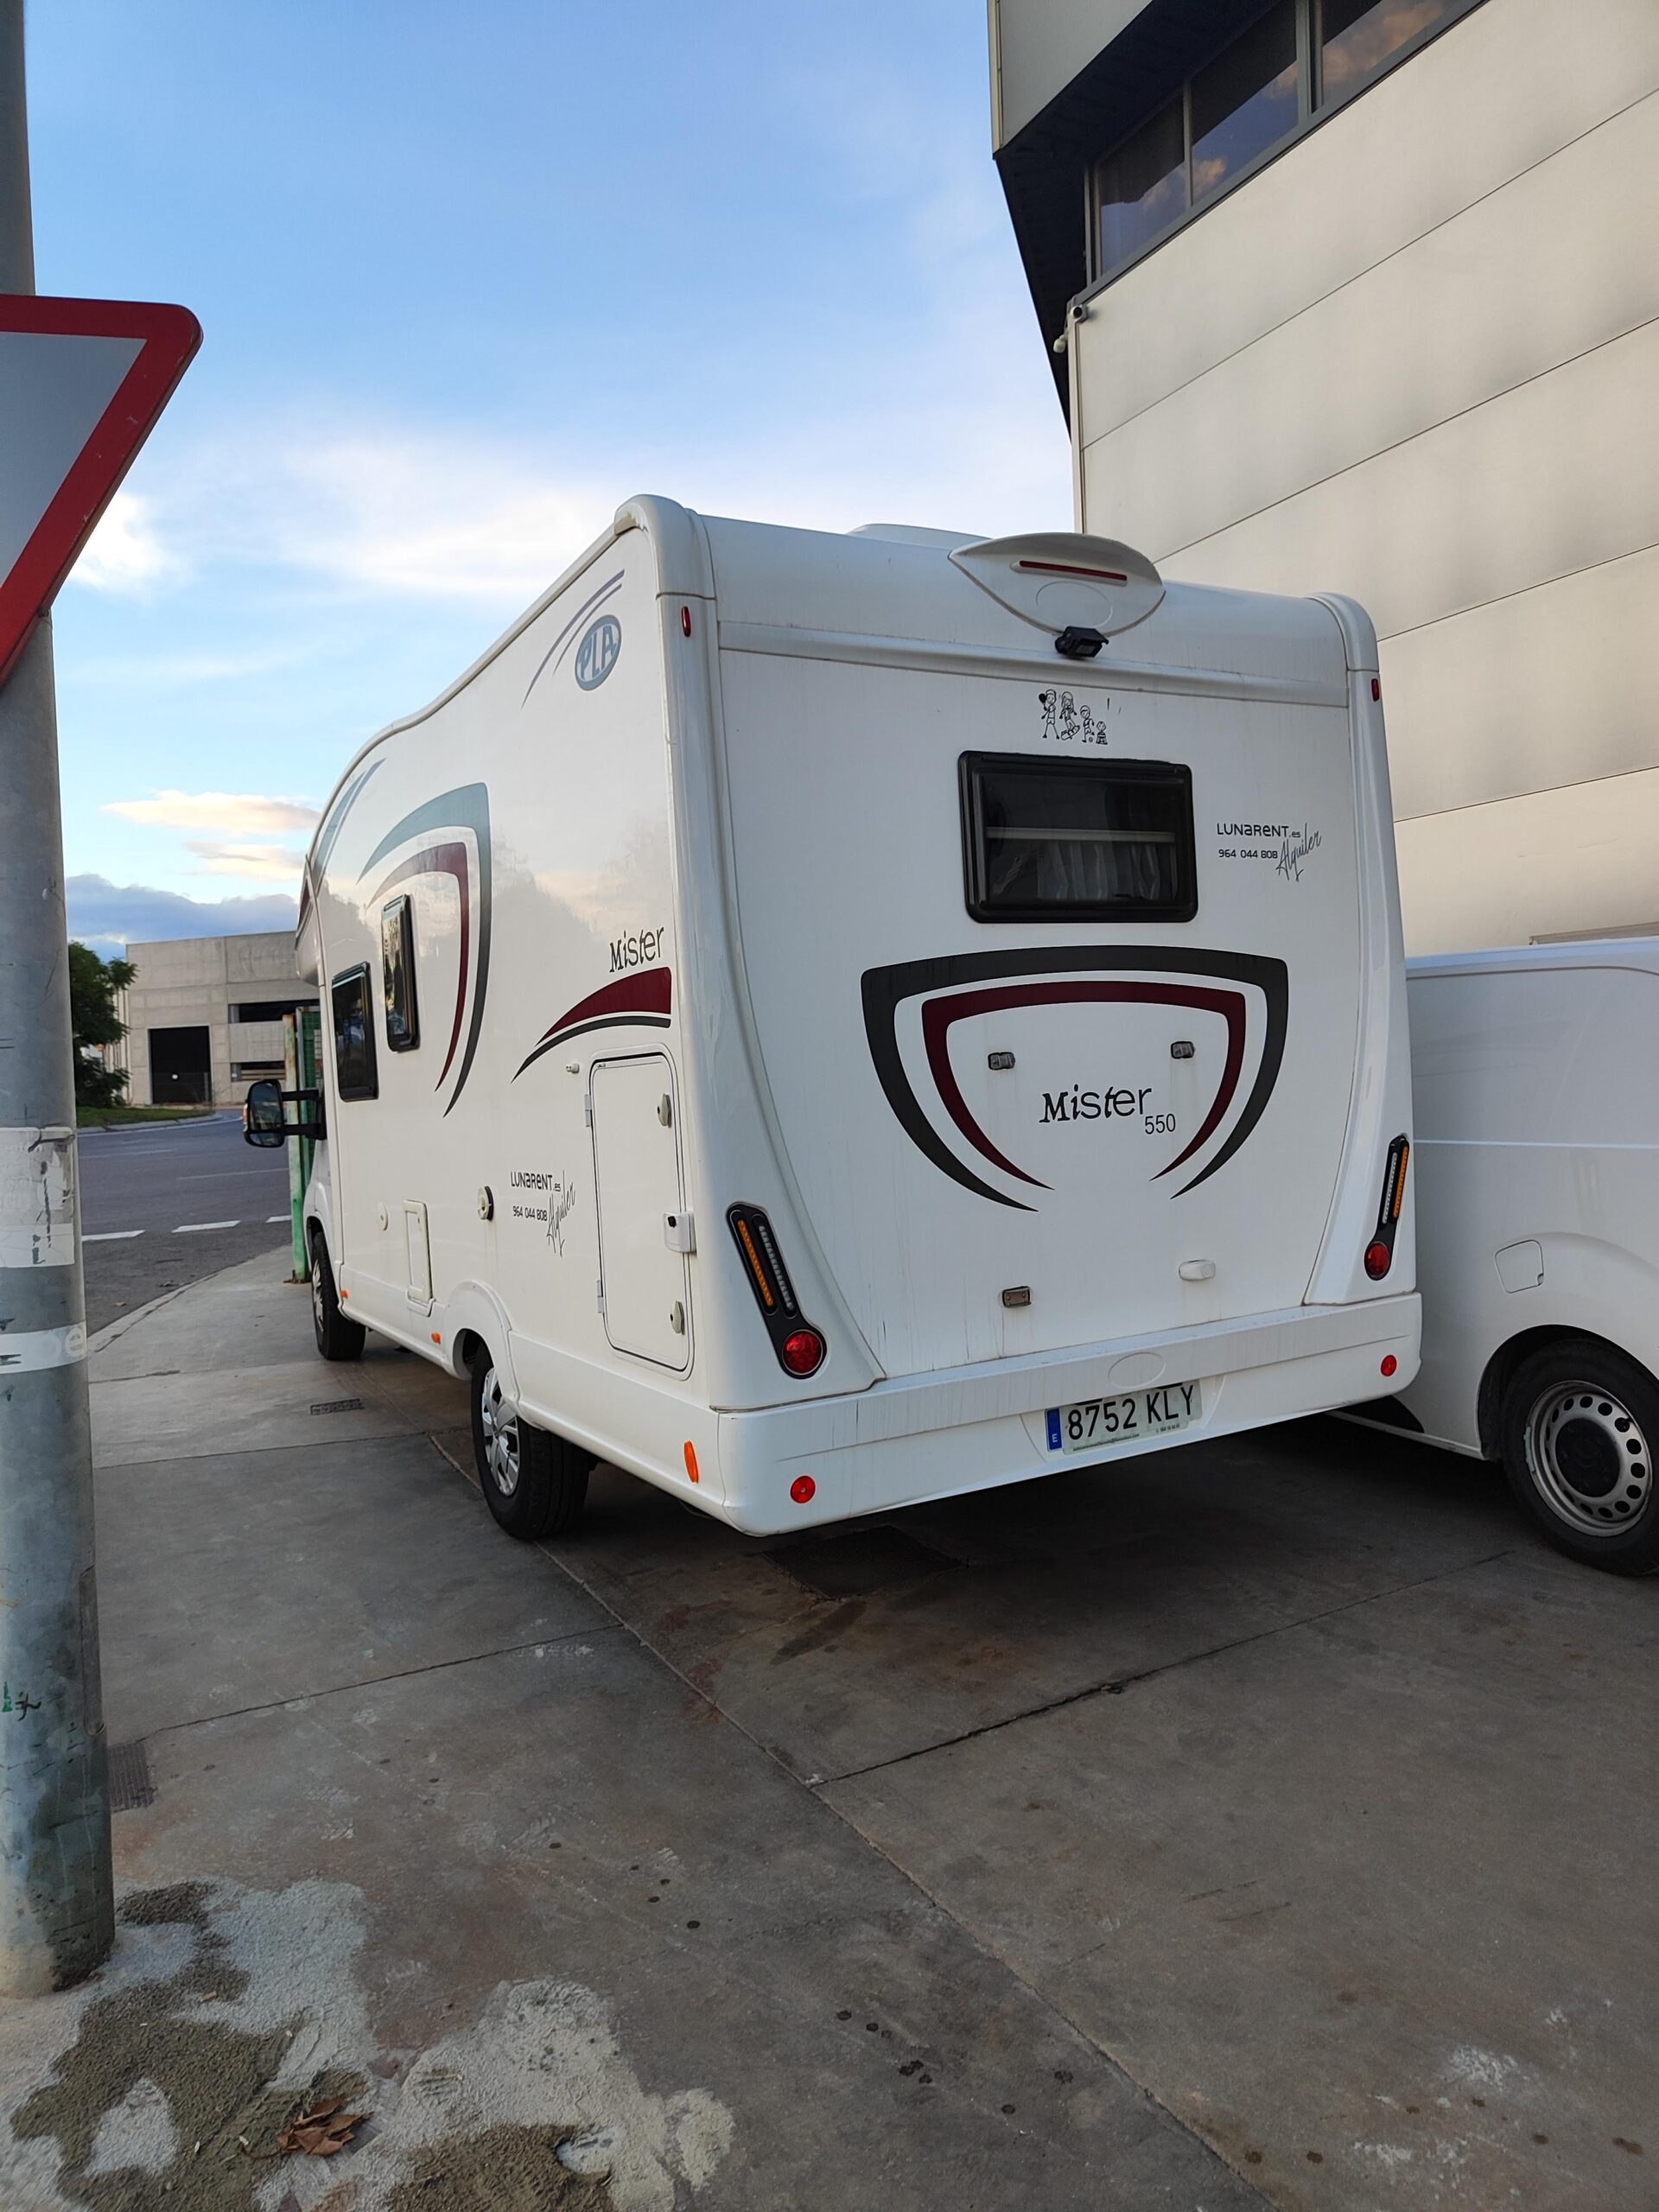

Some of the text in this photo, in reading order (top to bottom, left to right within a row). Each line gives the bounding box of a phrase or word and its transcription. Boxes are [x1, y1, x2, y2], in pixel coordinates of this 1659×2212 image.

[577, 625, 617, 681] PLA
[1218, 849, 1279, 859] 964 044 808
[1275, 823, 1322, 882] Alquiler
[609, 926, 664, 973] Mister
[1039, 1084, 1153, 1123] Mister
[1144, 1113, 1176, 1135] 550
[512, 1205, 548, 1221] 964 044 808
[1068, 1384, 1194, 1440] 8752 KLY
[1052, 1433, 1058, 1443] E
